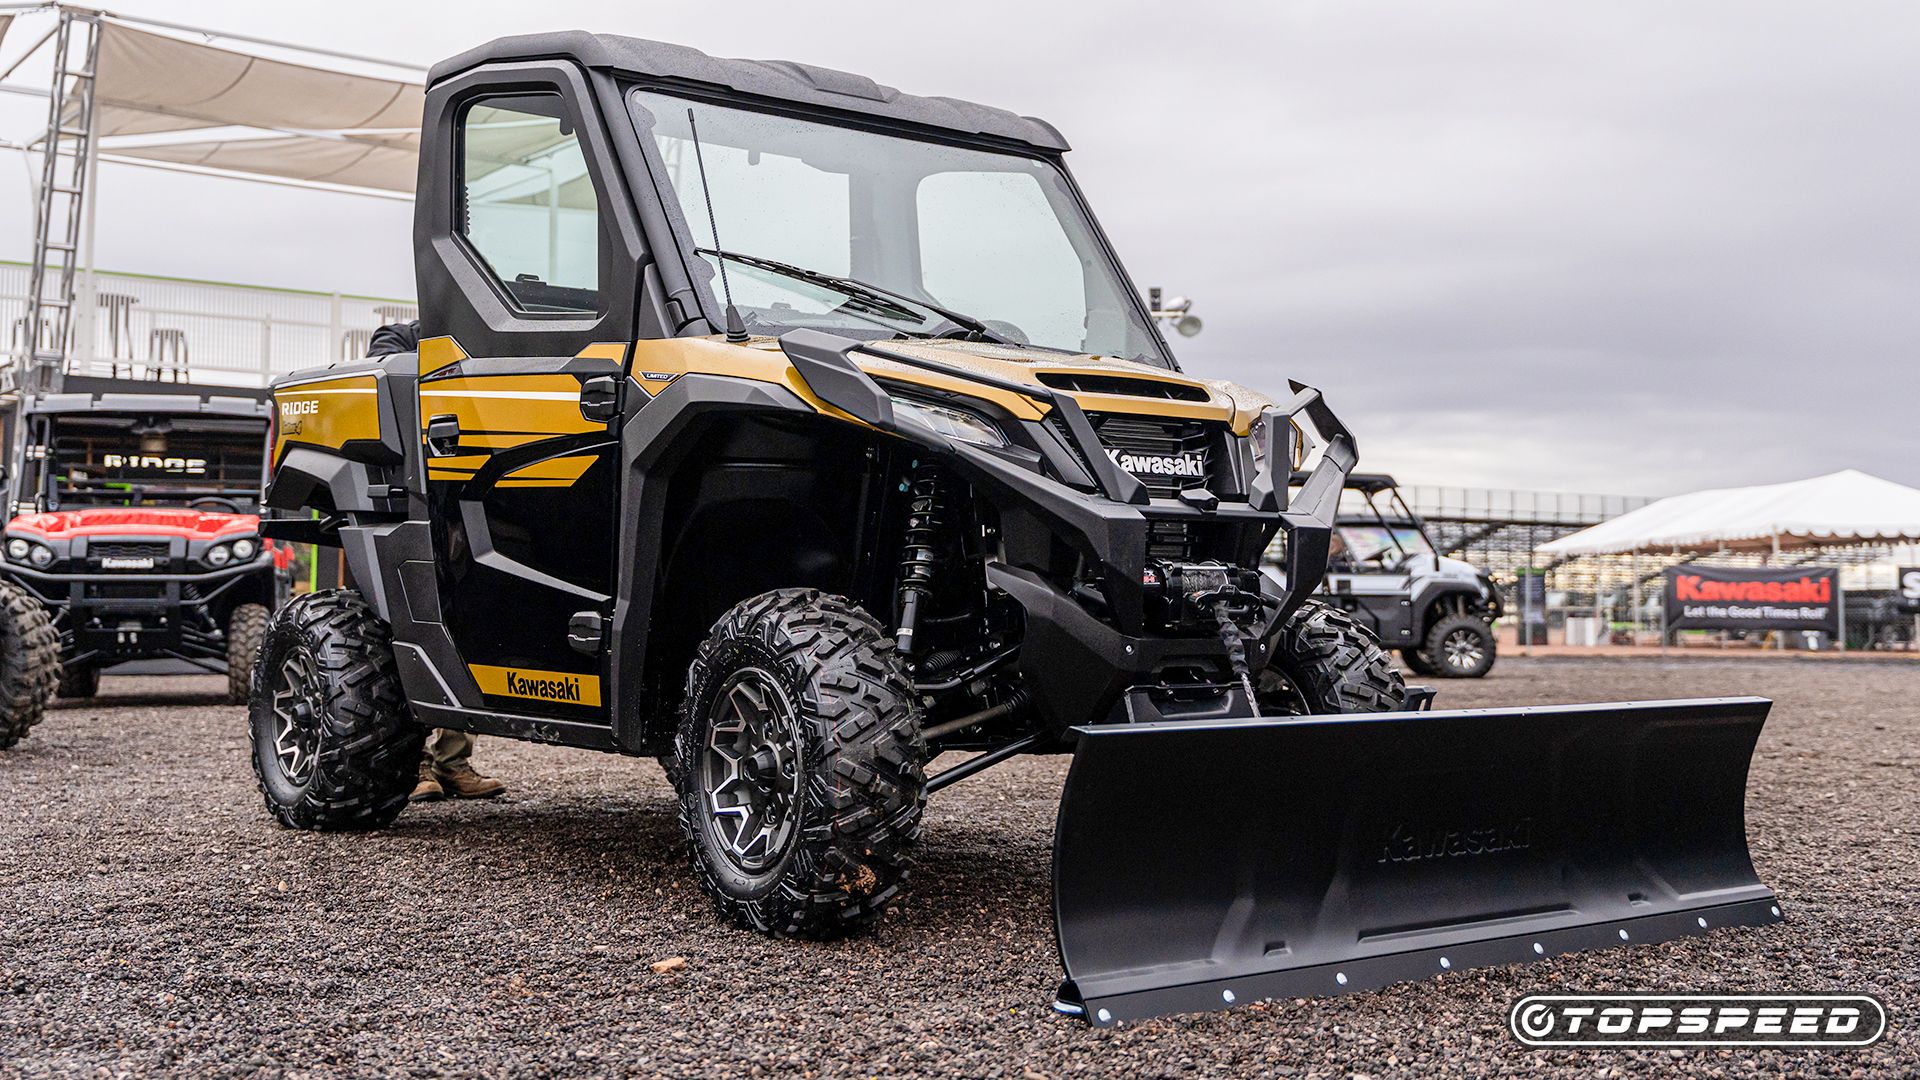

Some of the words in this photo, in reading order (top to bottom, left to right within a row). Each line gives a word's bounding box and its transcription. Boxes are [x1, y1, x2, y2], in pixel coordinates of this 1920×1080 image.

[281, 400, 320, 416] RIDGE
[1103, 448, 1205, 477] Kawasaki
[1676, 575, 1831, 603] Kawasaki
[1683, 605, 1706, 618] Let
[1706, 605, 1728, 618] the
[1728, 605, 1763, 619] Good
[1763, 606, 1800, 620] Times
[506, 671, 581, 701] Kawasaki
[1378, 818, 1532, 863] Kawasaki
